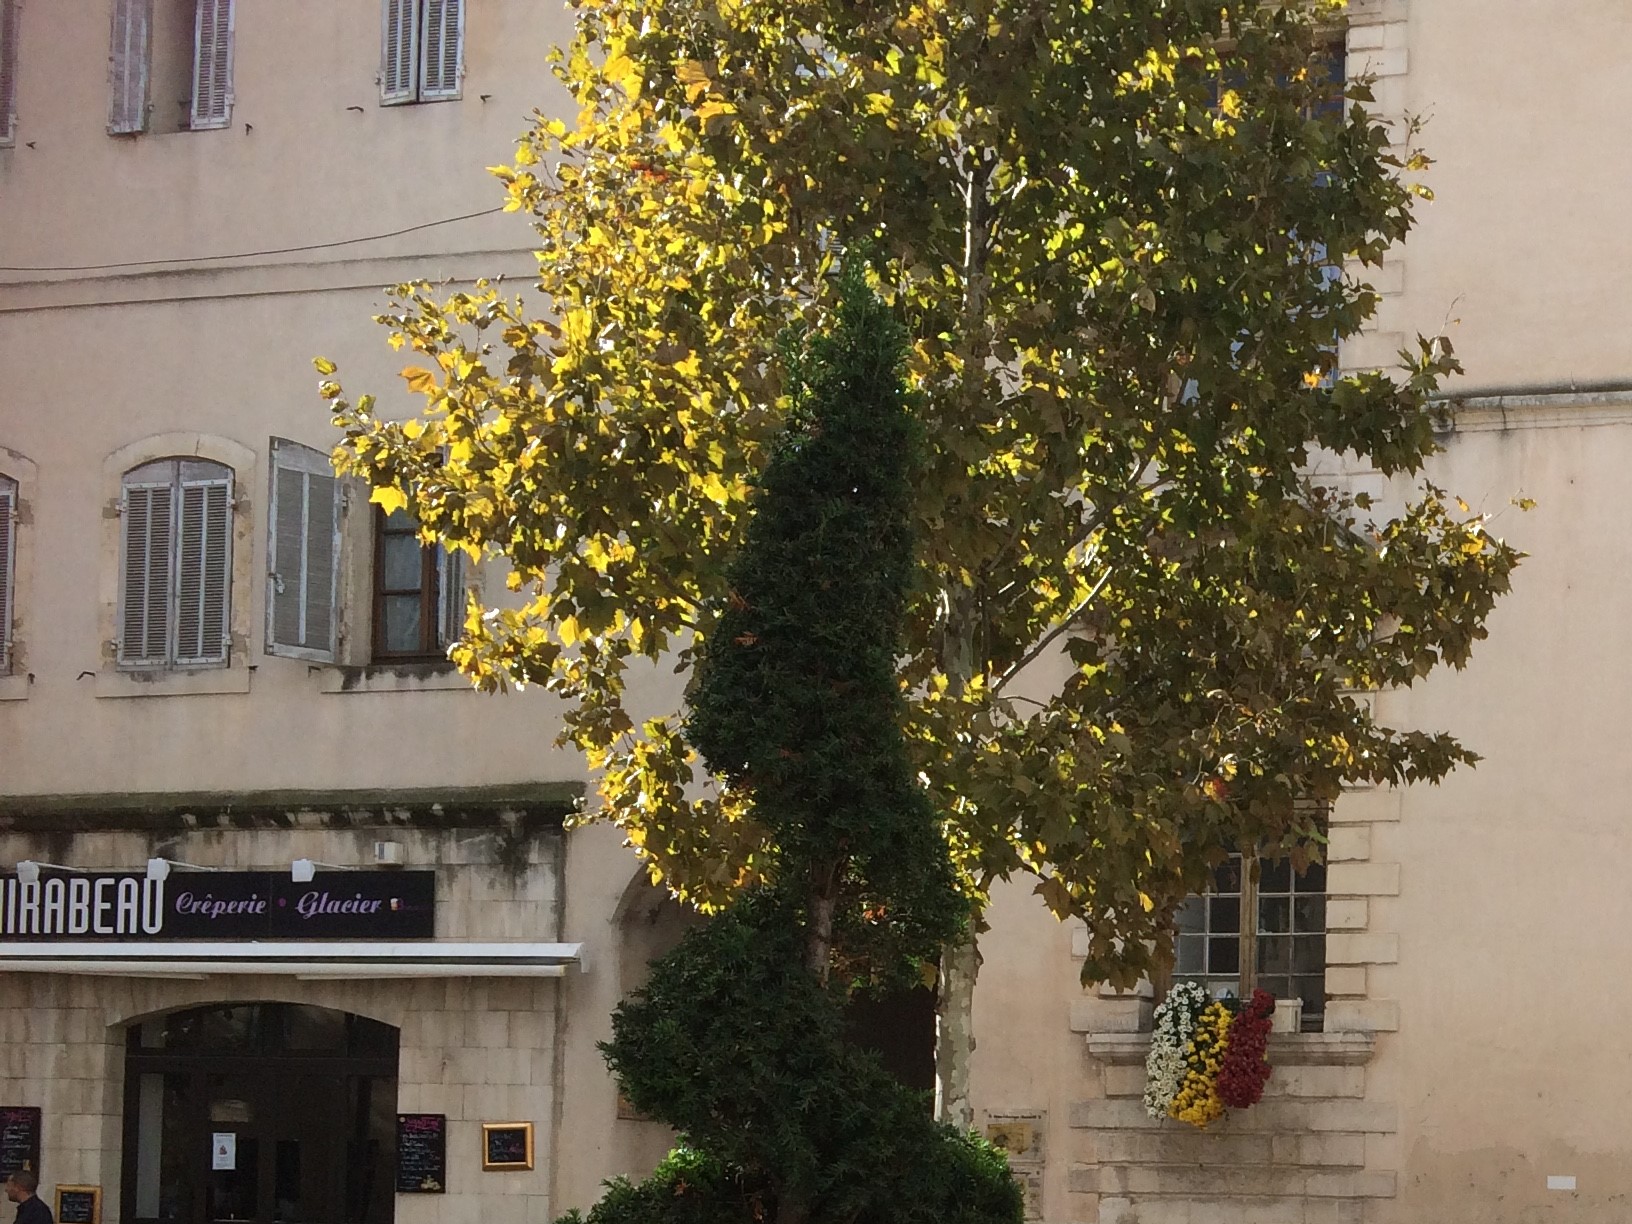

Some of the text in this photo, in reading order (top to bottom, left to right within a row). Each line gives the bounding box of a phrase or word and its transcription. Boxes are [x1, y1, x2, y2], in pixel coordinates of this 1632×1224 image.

[0, 878, 164, 934] IRABEAU
[176, 891, 382, 919] Crêperie Glacier
